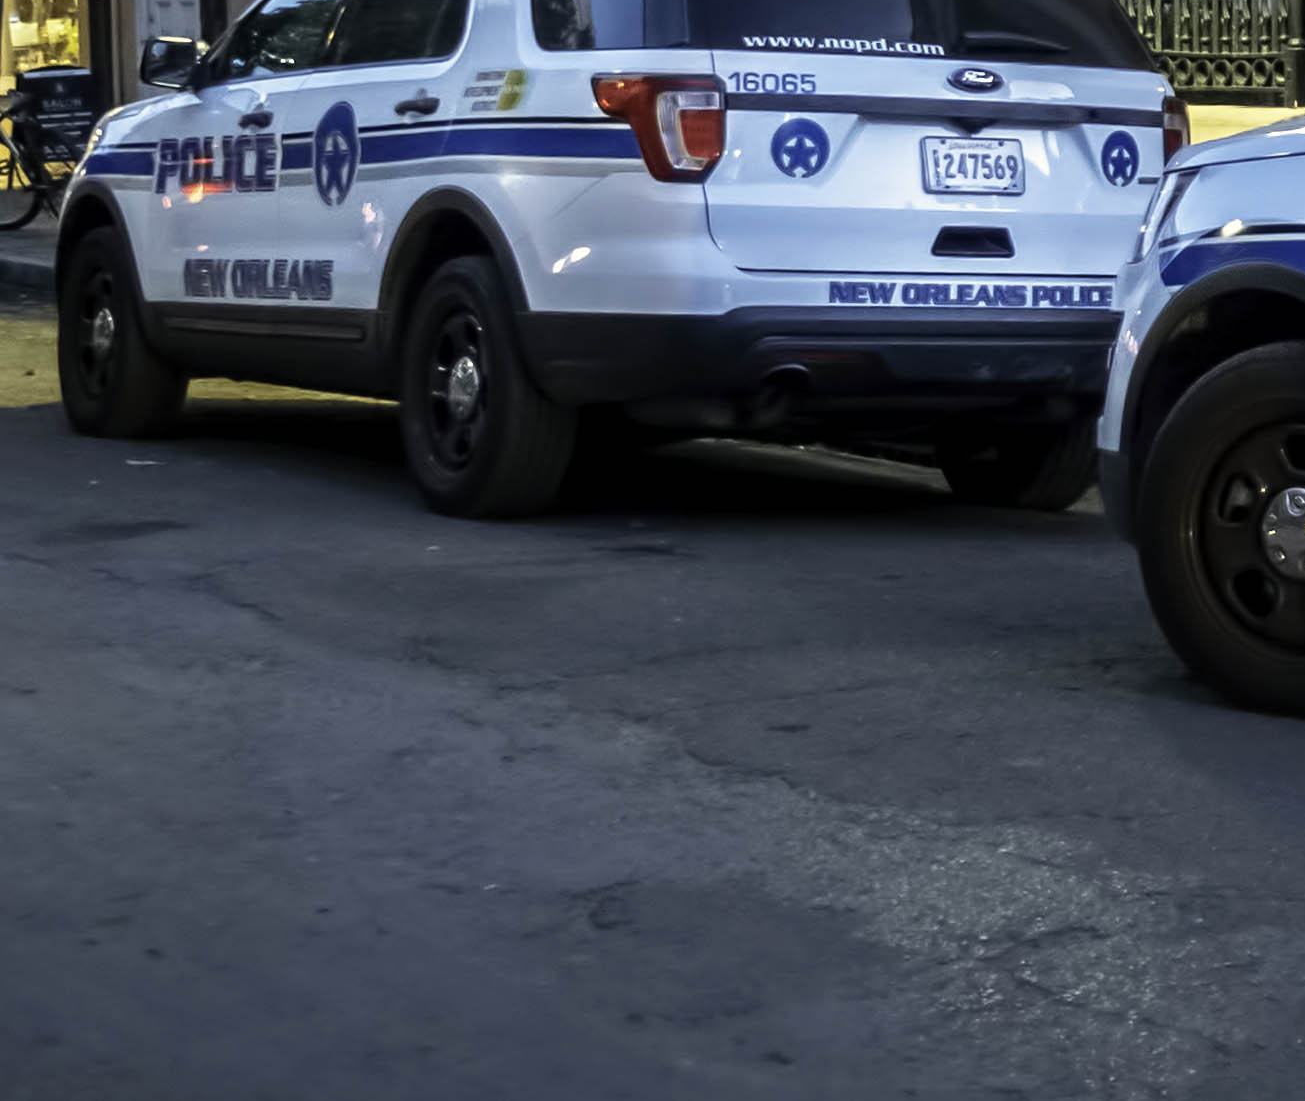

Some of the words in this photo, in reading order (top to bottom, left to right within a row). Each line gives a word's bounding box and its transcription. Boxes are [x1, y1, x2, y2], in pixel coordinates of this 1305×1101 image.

[743, 36, 945, 55] www.nopd.com
[728, 72, 817, 94] 16065
[155, 133, 277, 194] POLICE
[943, 153, 1018, 180] 247569
[184, 259, 231, 298] NEW
[231, 259, 334, 301] ORLEANS
[829, 281, 897, 304] NEW
[901, 283, 1027, 307] ORLEANS
[1031, 284, 1114, 307] POLICE
